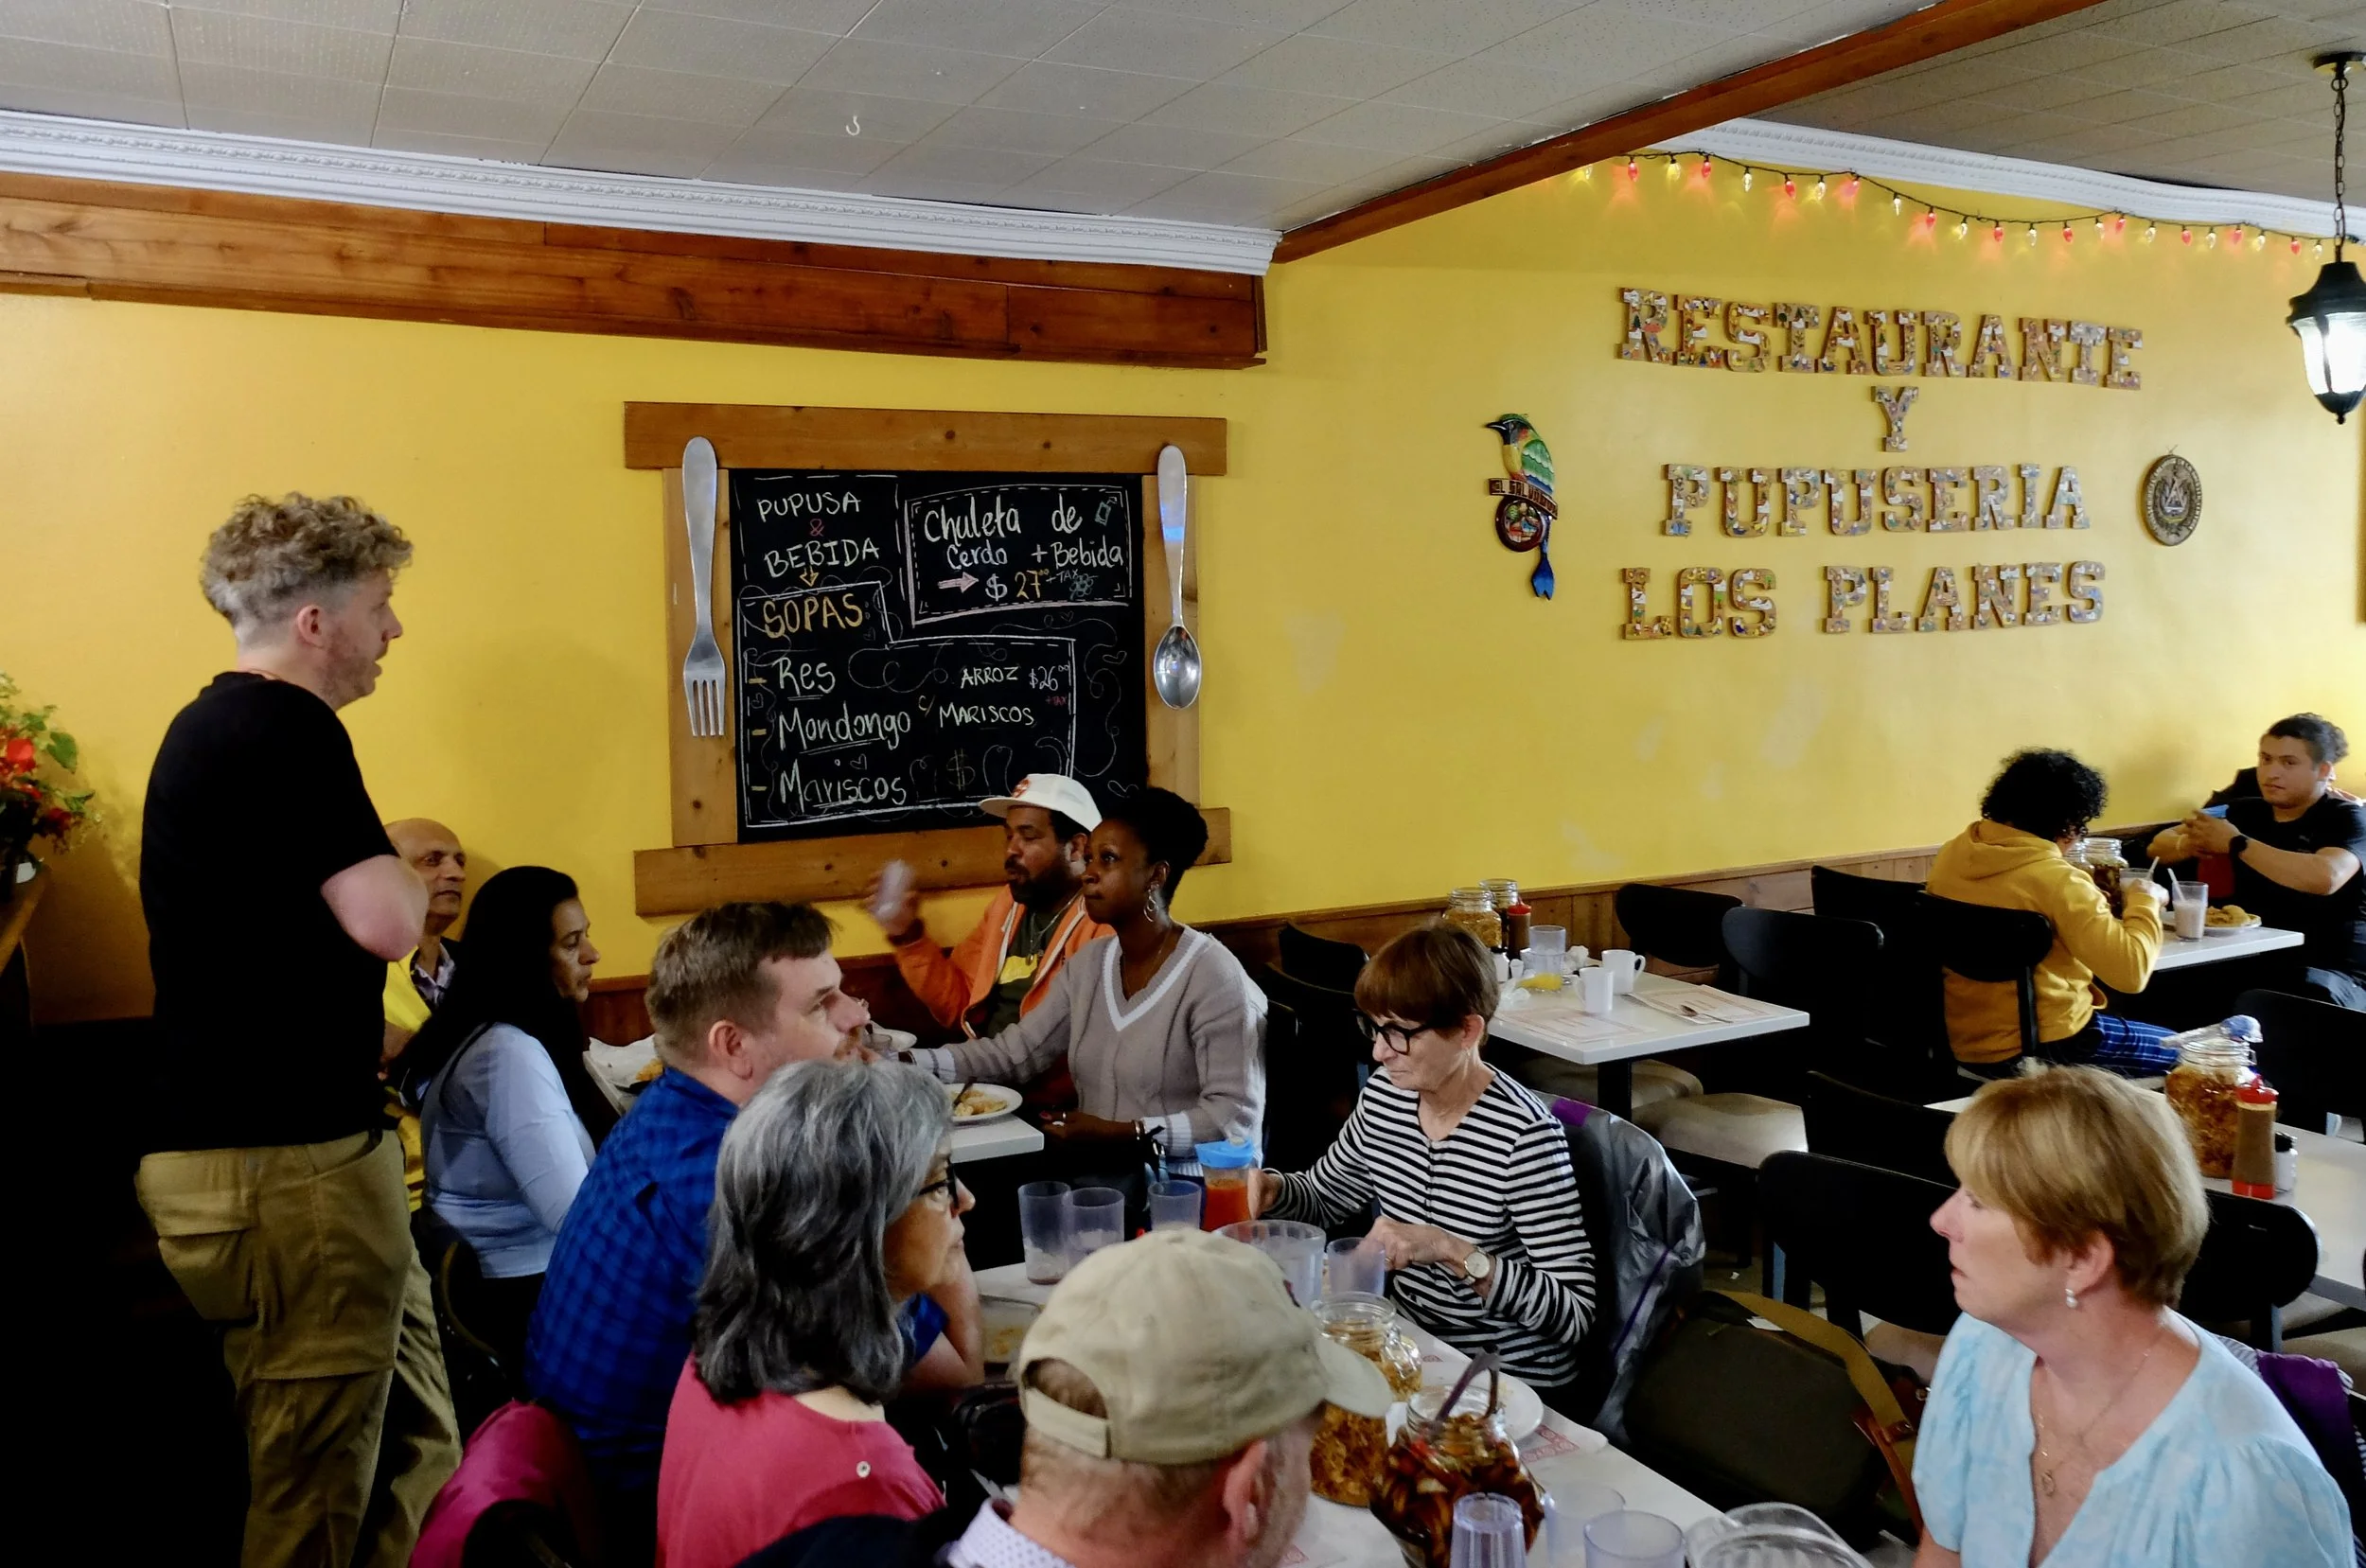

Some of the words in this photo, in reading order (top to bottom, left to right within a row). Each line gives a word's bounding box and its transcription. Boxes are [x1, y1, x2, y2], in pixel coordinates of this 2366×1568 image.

[1618, 286, 2143, 390] RESTAURANTE
[1872, 385, 1918, 453] Y
[757, 491, 861, 522] PUPUSA
[924, 492, 1021, 547] Chuleta
[1051, 493, 1083, 534] de
[1662, 463, 2091, 538] PUPUSERIA
[809, 518, 824, 537] &
[764, 537, 879, 578] BEBIDA
[1619, 567, 1776, 641] LOS
[1824, 560, 2106, 636] PLANES
[771, 657, 836, 696] Res
[961, 665, 1019, 689] ARROZ
[779, 700, 910, 750] Mondongo
[939, 702, 1034, 729] MARISCOS
[779, 759, 907, 814] Mariscos
